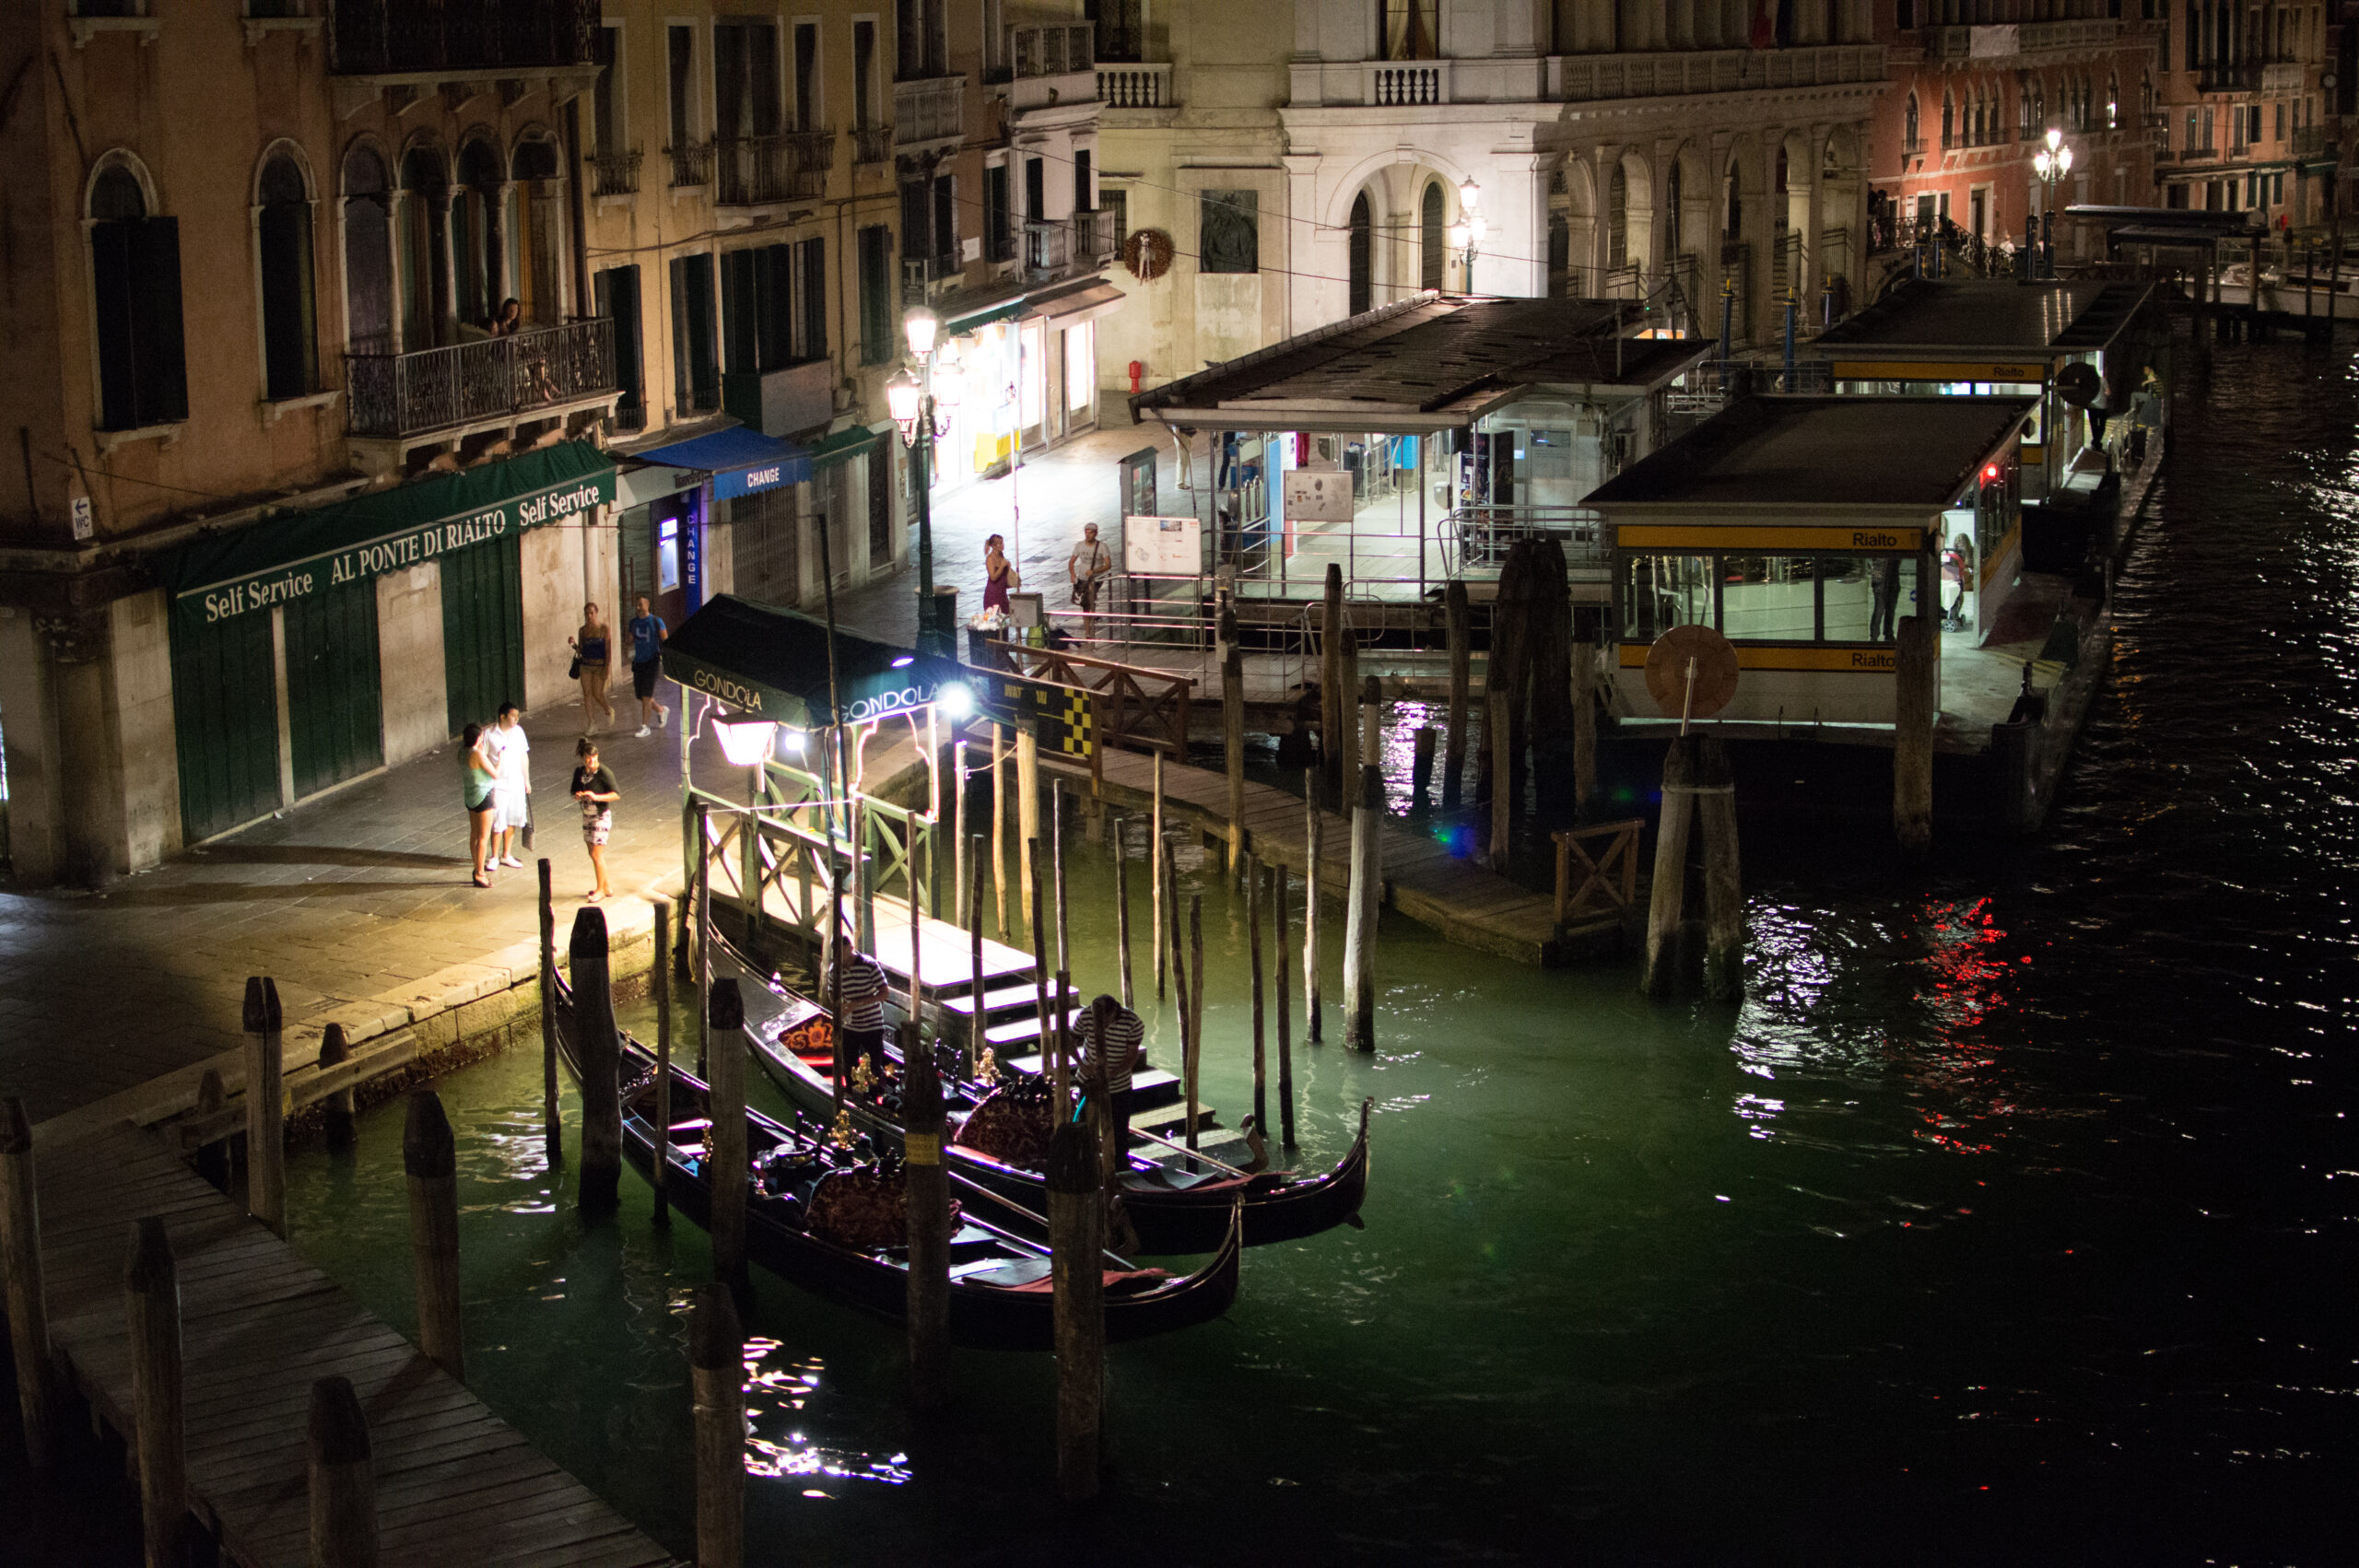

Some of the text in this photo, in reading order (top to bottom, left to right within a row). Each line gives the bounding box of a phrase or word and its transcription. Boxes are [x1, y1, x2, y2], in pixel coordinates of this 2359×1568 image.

[1994, 367, 2025, 377] Rialto
[747, 467, 780, 487] CHANGE
[75, 515, 89, 529] WC
[1852, 532, 1897, 546] Rialto
[205, 485, 599, 623] Self Service AL PONTE DI RIALTO Self Service
[687, 515, 696, 584] CHANGE
[1852, 652, 1895, 667] Rialto
[694, 670, 763, 711] GONDOLA
